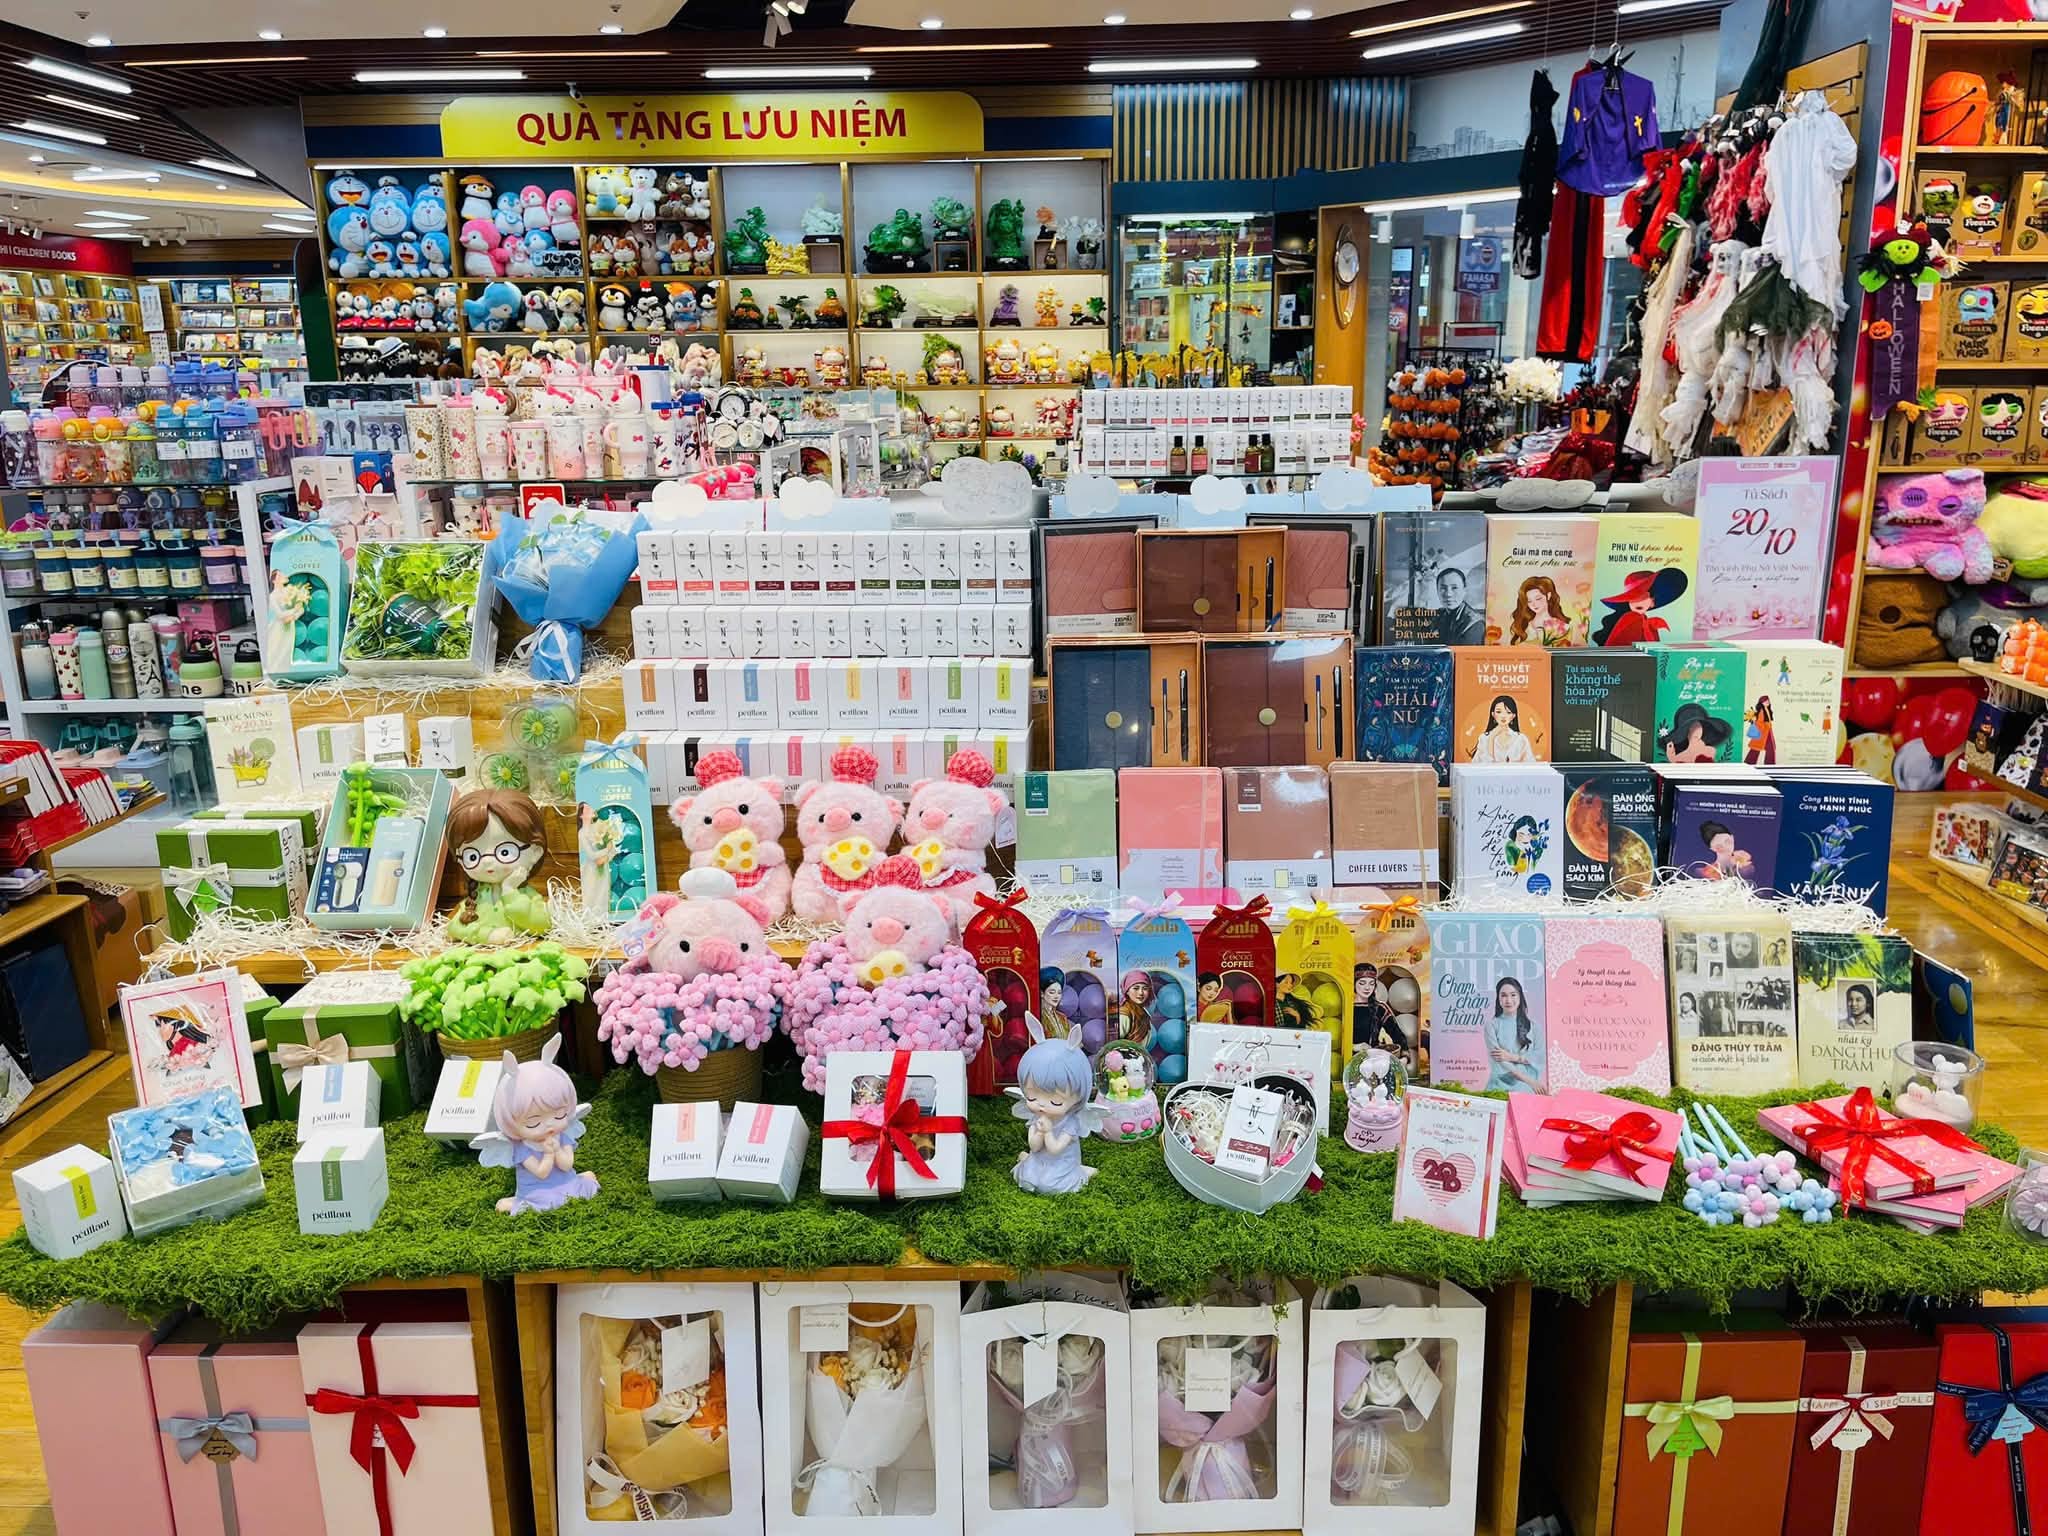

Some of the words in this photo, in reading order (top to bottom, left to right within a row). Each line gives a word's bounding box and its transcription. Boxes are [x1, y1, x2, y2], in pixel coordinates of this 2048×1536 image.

[517, 103, 601, 146] QUÀ
[607, 103, 712, 149] TẶNG
[722, 105, 799, 141] LƯU
[811, 100, 907, 147] NIỆM
[1760, 488, 1788, 500] Sách
[1395, 608, 1412, 617] Gia
[1565, 674, 1601, 686] không
[1384, 690, 1428, 706] PHÁI
[1392, 707, 1420, 724] NỮ
[1613, 793, 1633, 803] ĐÀN
[1634, 792, 1656, 803] ÔNG
[1823, 795, 1846, 804] BÌNH
[1613, 804, 1634, 812] SAO
[1819, 804, 1846, 813] HẠNH
[1848, 805, 1873, 814] PHÚC
[1348, 864, 1376, 873] COFFEE
[1378, 863, 1408, 873] LOVERS
[1568, 863, 1590, 873] ĐÀN
[1590, 863, 1605, 873] BÀ
[1565, 873, 1586, 882] SAO
[1587, 873, 1605, 882] KIM
[1433, 920, 1544, 956] GIAO
[1221, 960, 1254, 969] COFFEE
[1299, 961, 1333, 969] COFFEE
[1692, 1042, 1722, 1054] ĐẶNG
